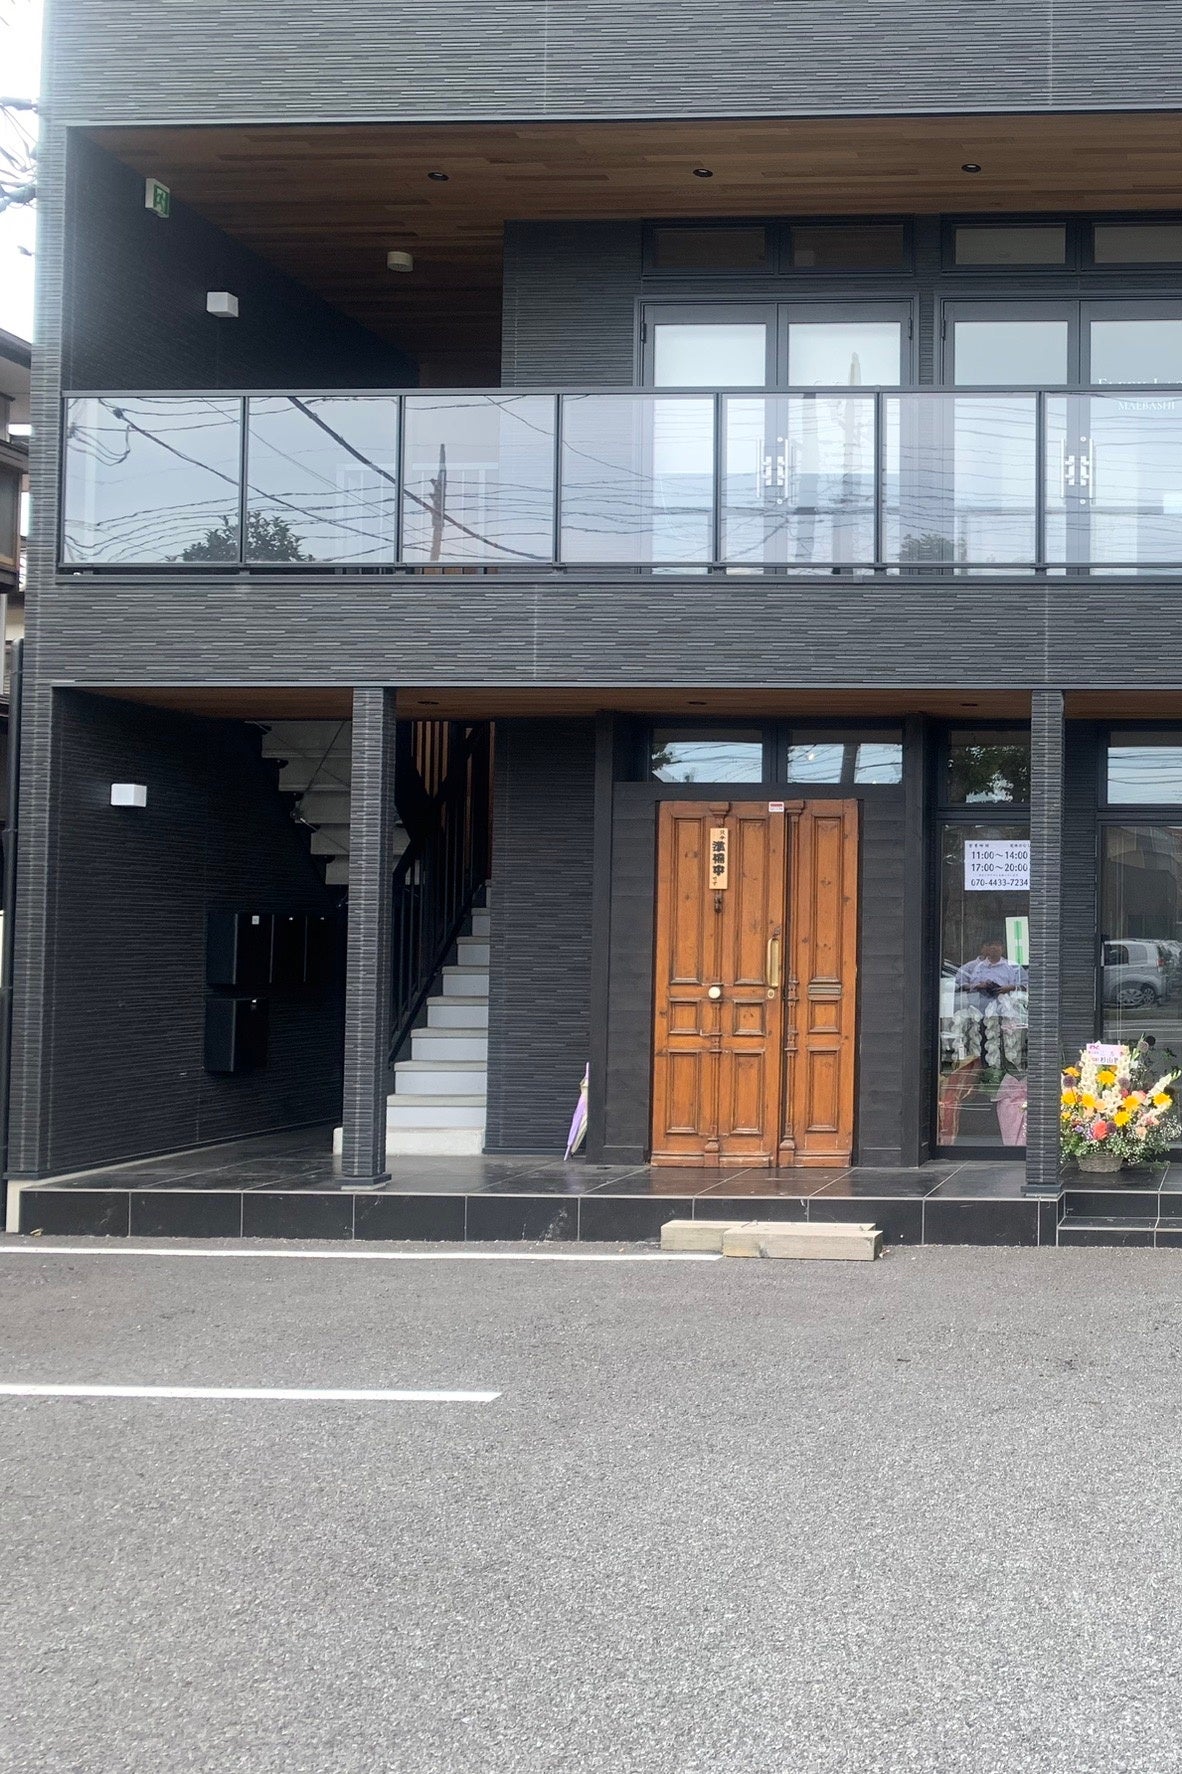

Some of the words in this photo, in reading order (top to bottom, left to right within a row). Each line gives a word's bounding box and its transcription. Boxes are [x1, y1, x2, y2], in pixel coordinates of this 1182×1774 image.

[712, 841, 725, 876] 準備中
[970, 879, 1029, 887] 070-4433-7234
